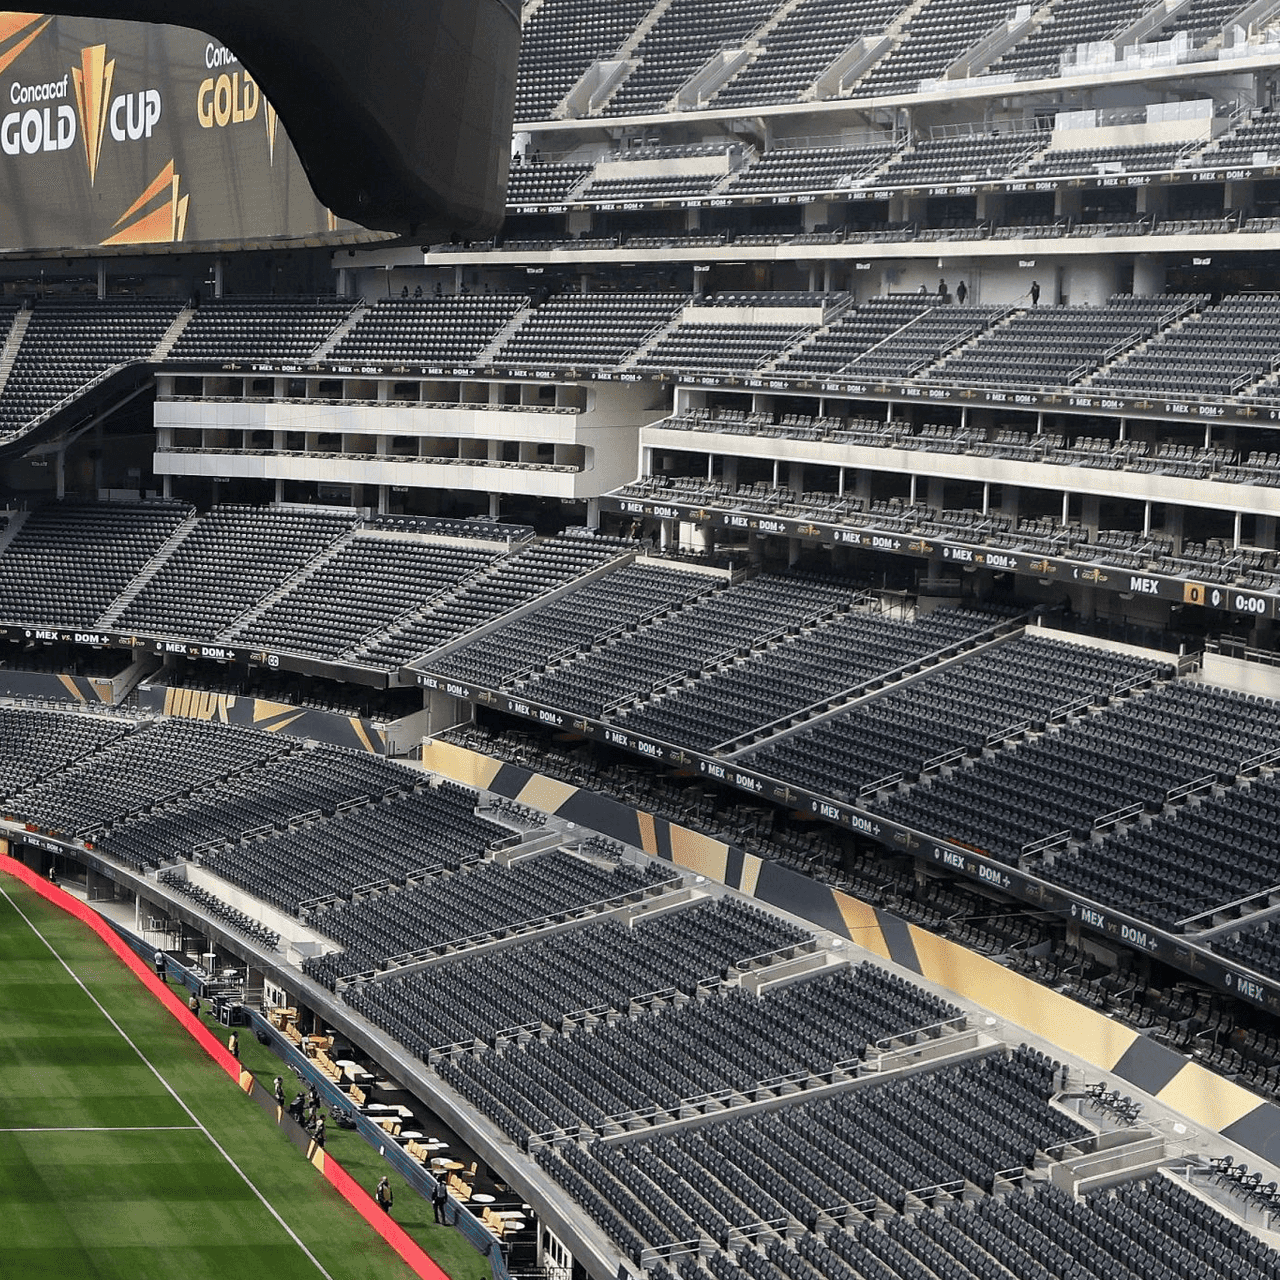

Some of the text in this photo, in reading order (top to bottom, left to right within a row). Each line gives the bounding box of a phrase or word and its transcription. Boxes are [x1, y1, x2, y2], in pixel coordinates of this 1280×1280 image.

[10, 74, 69, 106] Concacaf
[197, 70, 260, 129] GOLD
[0, 88, 161, 156] GOLD CUP
[953, 549, 972, 561] MEX
[987, 554, 1009, 567] DOM
[1131, 577, 1158, 593] MEX
[1236, 596, 1265, 613] 0:00
[167, 641, 186, 653] MEX
[202, 647, 224, 658] DOM
[944, 851, 964, 869] MEX
[979, 865, 1002, 885] DOM
[1082, 908, 1104, 928] MEX
[1122, 925, 1146, 947] DOM
